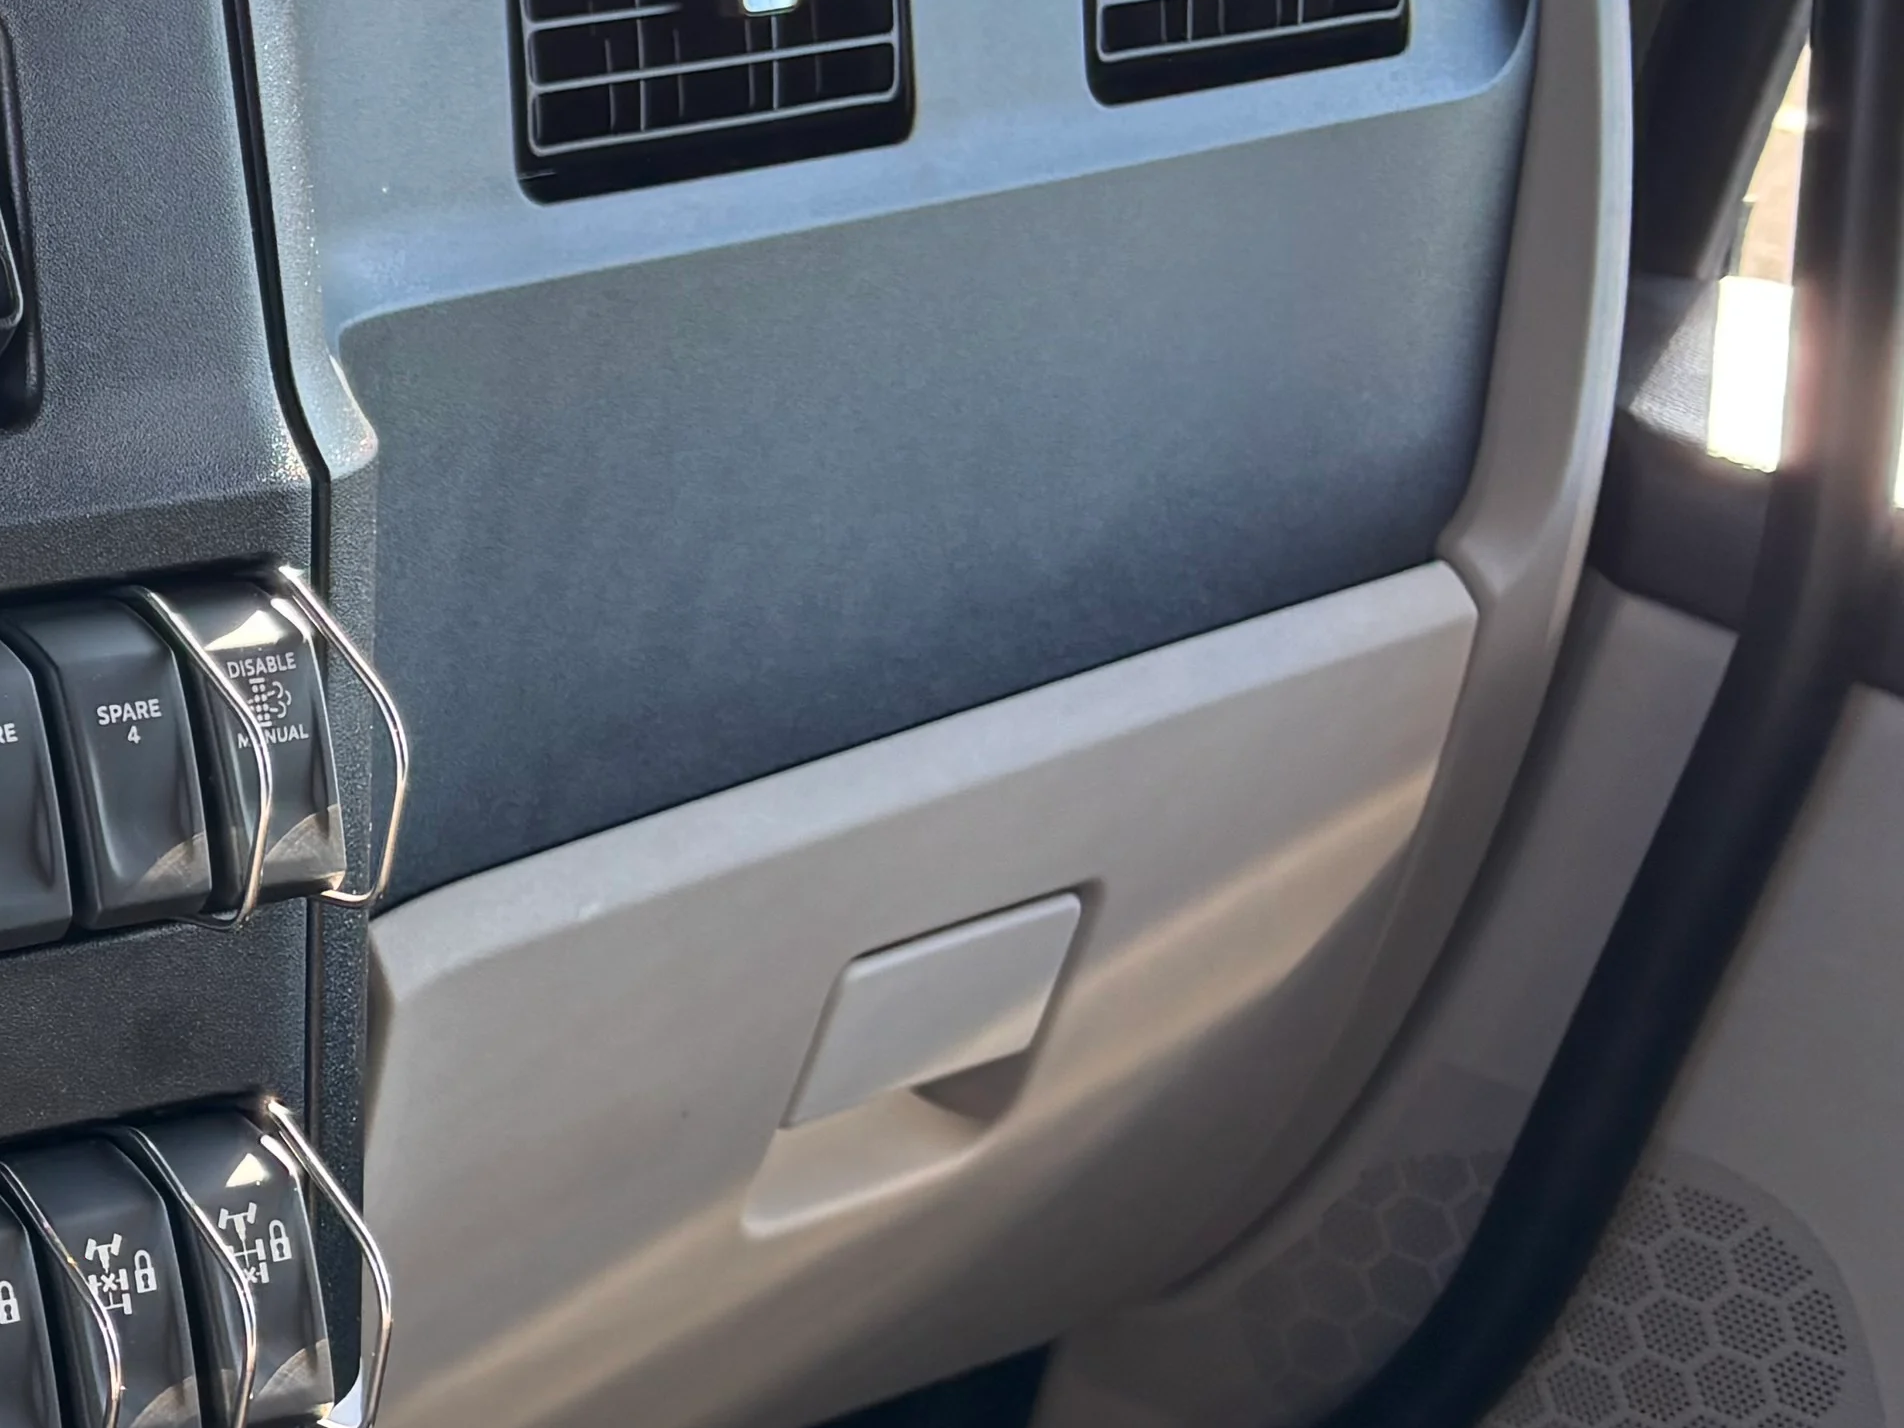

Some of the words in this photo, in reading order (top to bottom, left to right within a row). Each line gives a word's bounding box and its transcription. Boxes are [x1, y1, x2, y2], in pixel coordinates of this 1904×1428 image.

[227, 652, 296, 678] DISABLE
[96, 698, 163, 728] SPARE
[126, 724, 141, 746] 4
[237, 724, 309, 748] MNUAL
